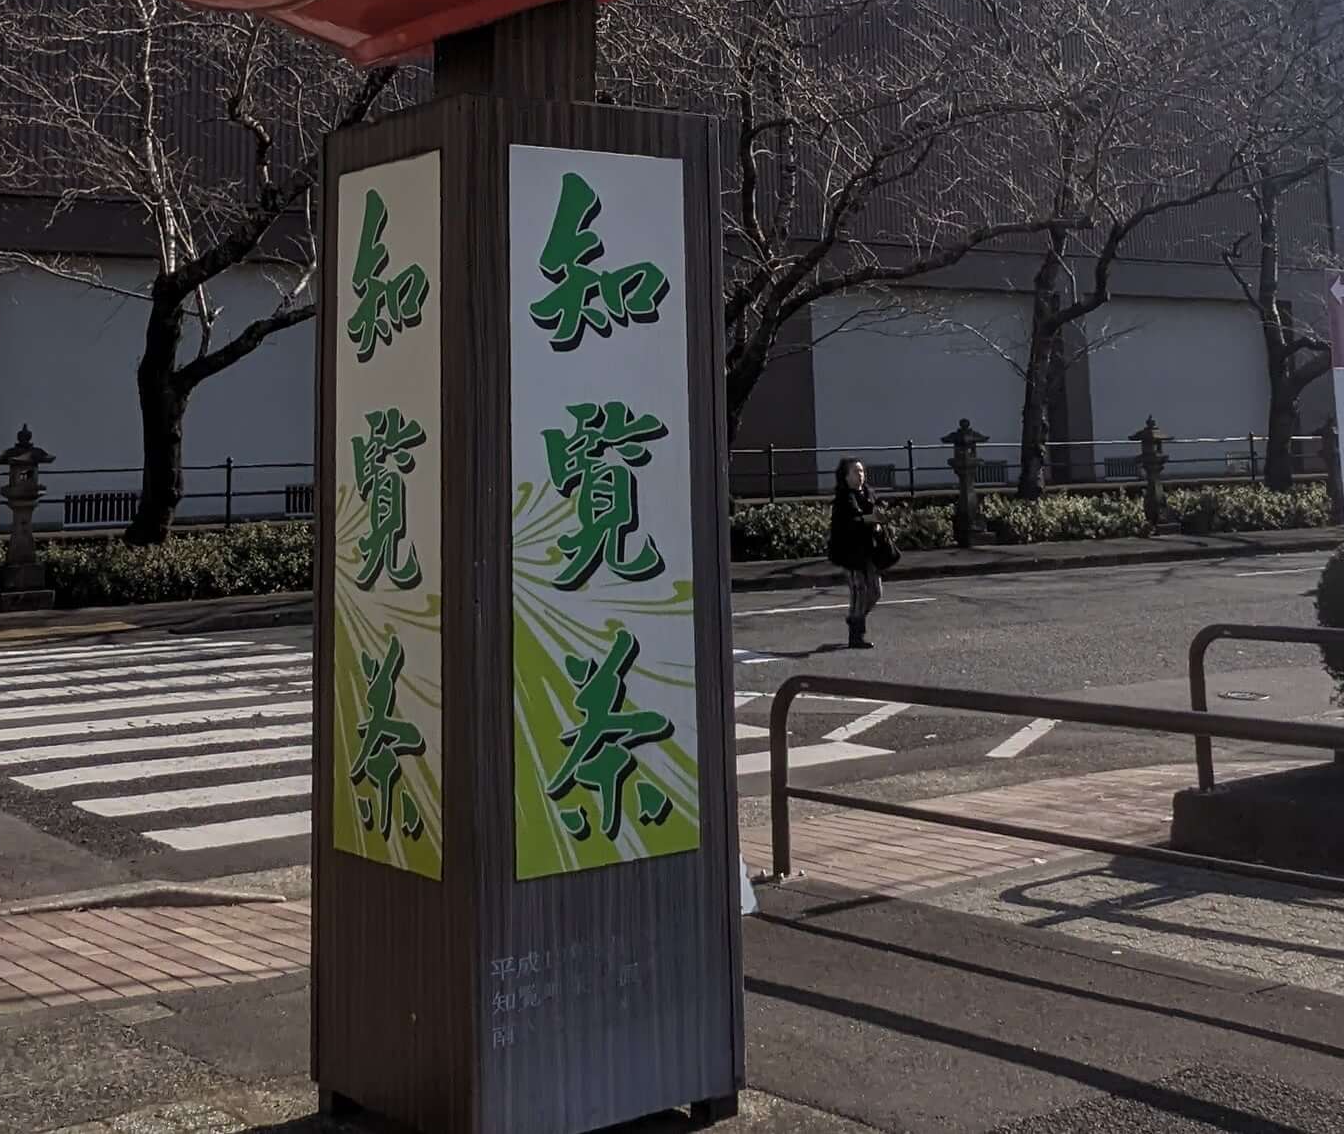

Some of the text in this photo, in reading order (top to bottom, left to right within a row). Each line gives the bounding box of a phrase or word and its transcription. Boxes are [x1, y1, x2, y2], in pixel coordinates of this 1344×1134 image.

[349, 188, 430, 842] 知覧茶
[529, 172, 676, 841] 知覧茶
